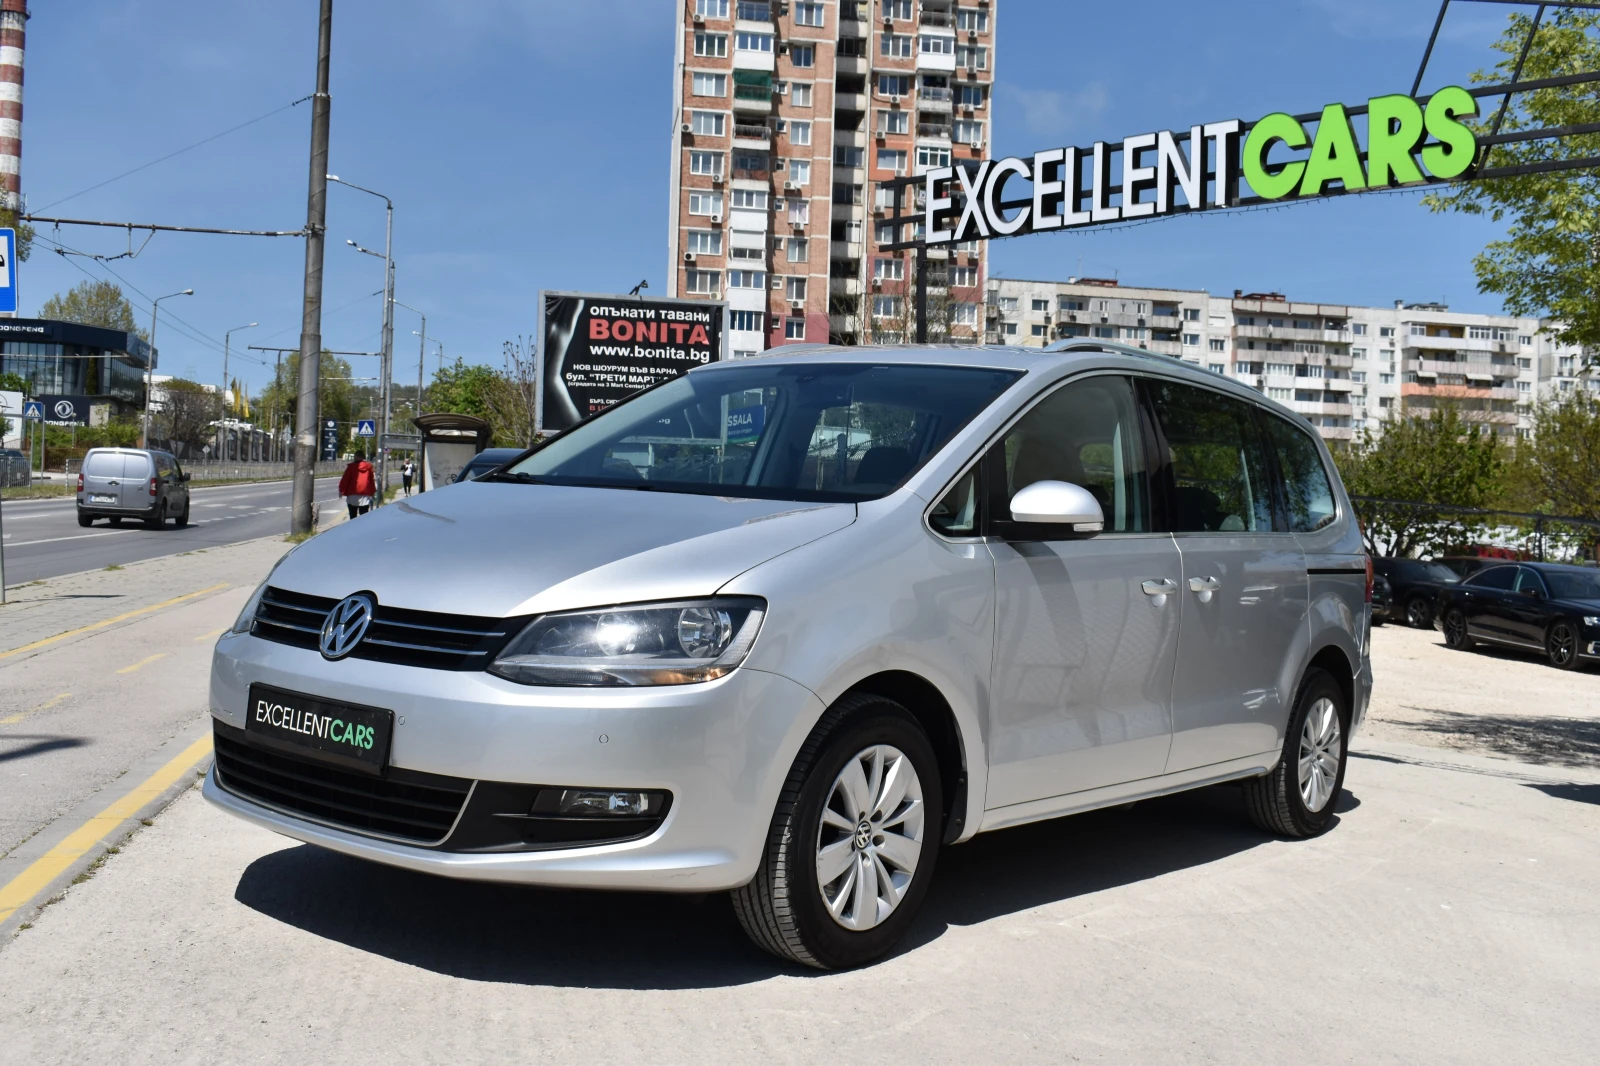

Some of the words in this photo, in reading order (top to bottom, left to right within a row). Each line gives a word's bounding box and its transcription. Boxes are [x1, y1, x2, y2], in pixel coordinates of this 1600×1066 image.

[590, 306, 655, 319] опънати
[659, 310, 710, 322] тавани
[589, 318, 710, 345] BONITA
[589, 345, 710, 363] www.bonita.bg
[566, 372, 587, 381] бул.
[592, 365, 628, 373] ШОУРУМ
